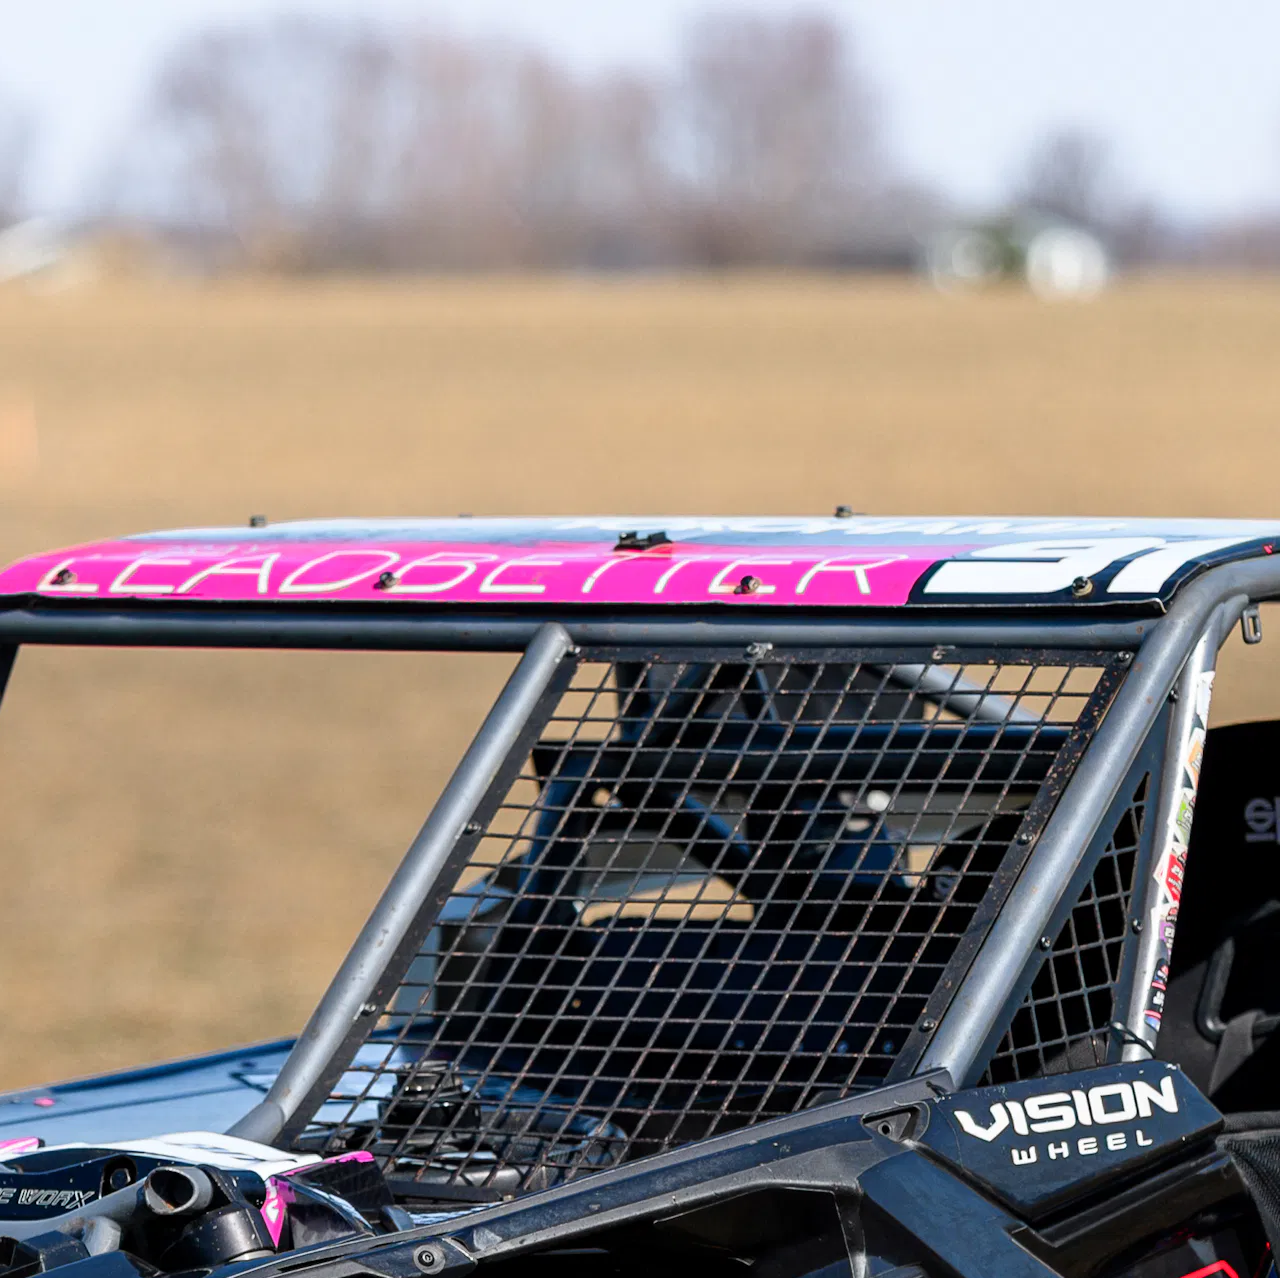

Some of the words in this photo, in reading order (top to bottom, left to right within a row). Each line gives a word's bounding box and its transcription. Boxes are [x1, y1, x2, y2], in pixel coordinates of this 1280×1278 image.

[35, 550, 908, 595] LEADBETTER
[923, 537, 1235, 594] 91
[953, 1076, 1179, 1142] VISION
[1011, 1130, 1153, 1165] WHEEL
[19, 1188, 96, 1209] WORX
